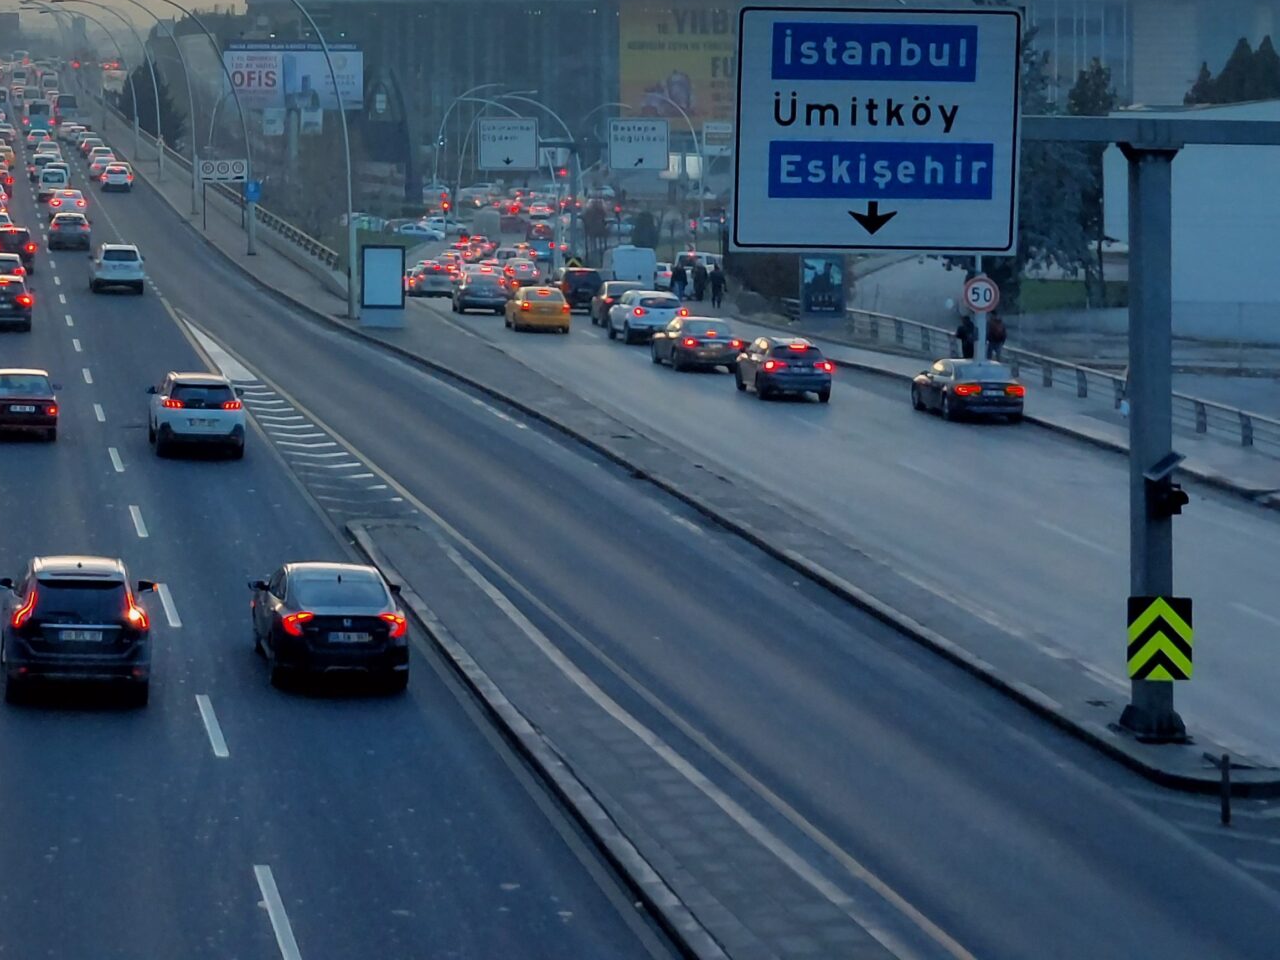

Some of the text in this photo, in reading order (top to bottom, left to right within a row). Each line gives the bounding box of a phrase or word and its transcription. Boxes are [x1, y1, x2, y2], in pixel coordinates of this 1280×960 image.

[783, 29, 967, 67] İstanbul
[231, 70, 277, 88] OFİS
[774, 91, 959, 133] Ümitköy
[780, 153, 988, 189] Eskişehir
[972, 287, 992, 303] 50
